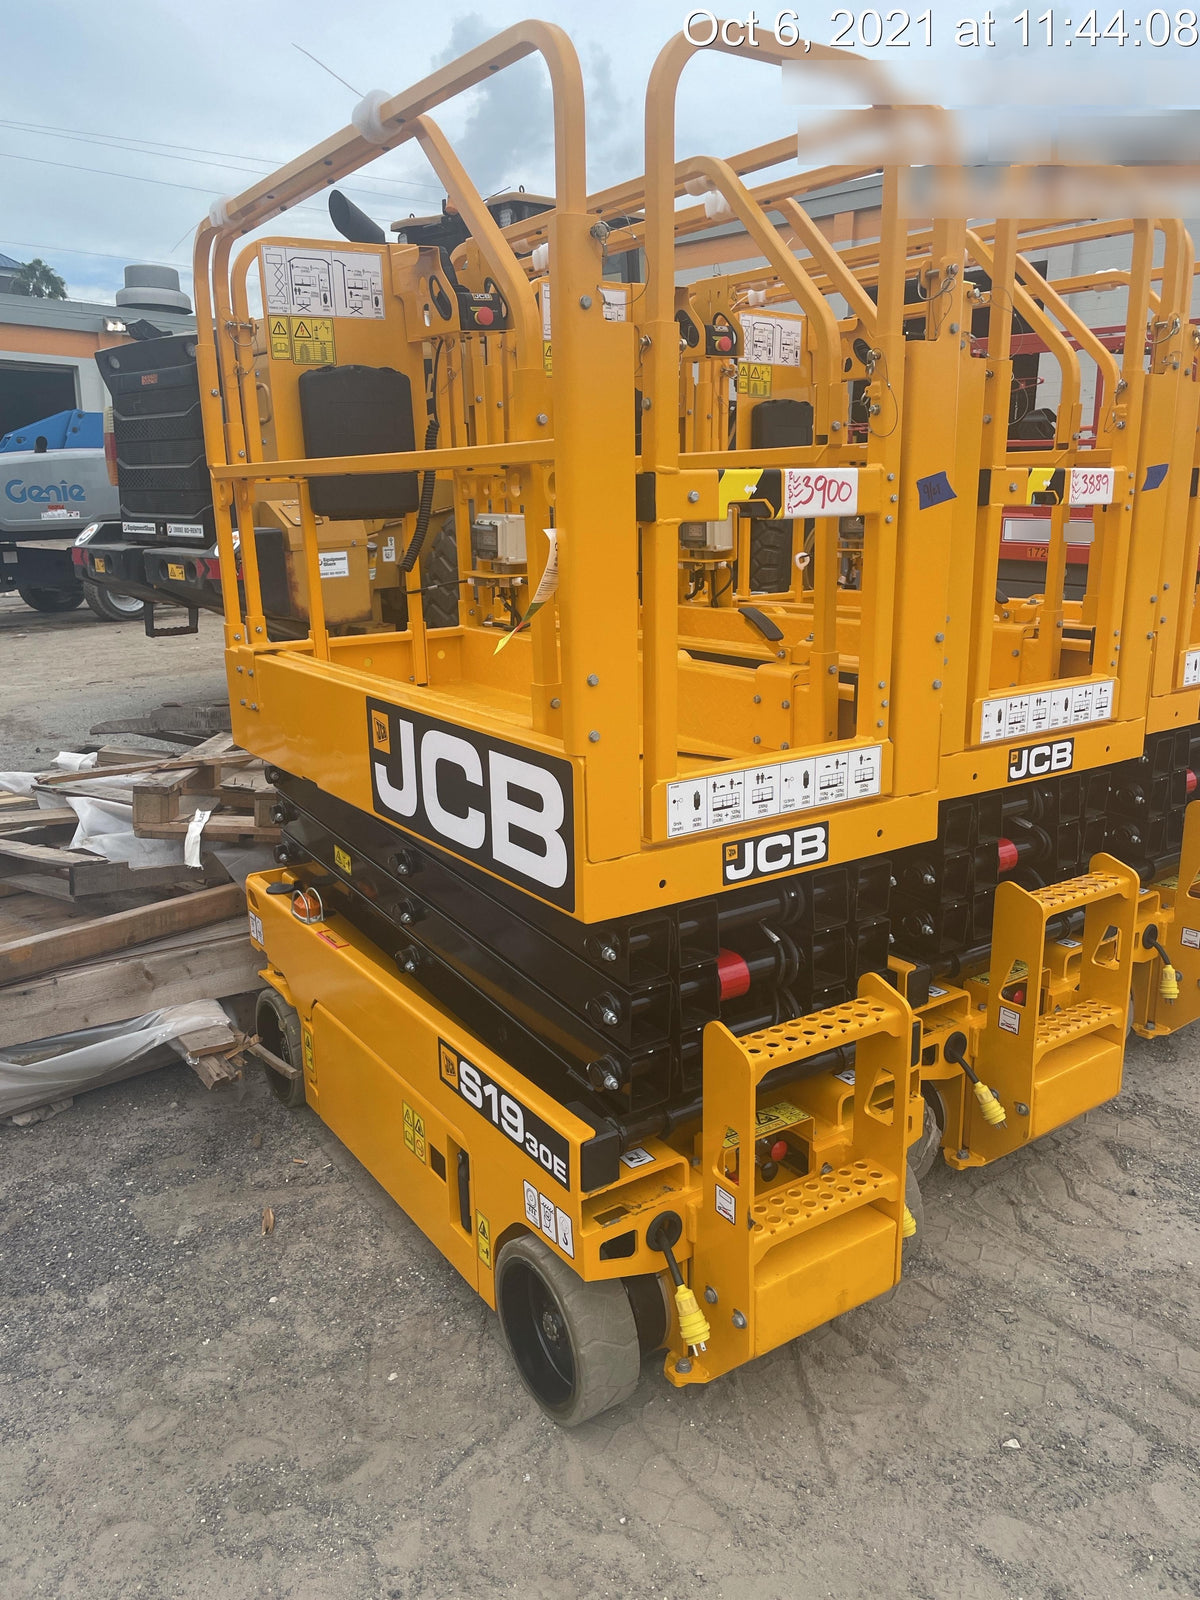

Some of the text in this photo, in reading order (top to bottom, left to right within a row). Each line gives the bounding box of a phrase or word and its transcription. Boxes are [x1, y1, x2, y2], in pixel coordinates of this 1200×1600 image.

[5, 479, 86, 504] Genie
[802, 475, 853, 509] 3900
[1082, 473, 1109, 494] 3889
[1009, 741, 1072, 778] JCB
[375, 719, 568, 888] JCB
[726, 827, 827, 881] JCB
